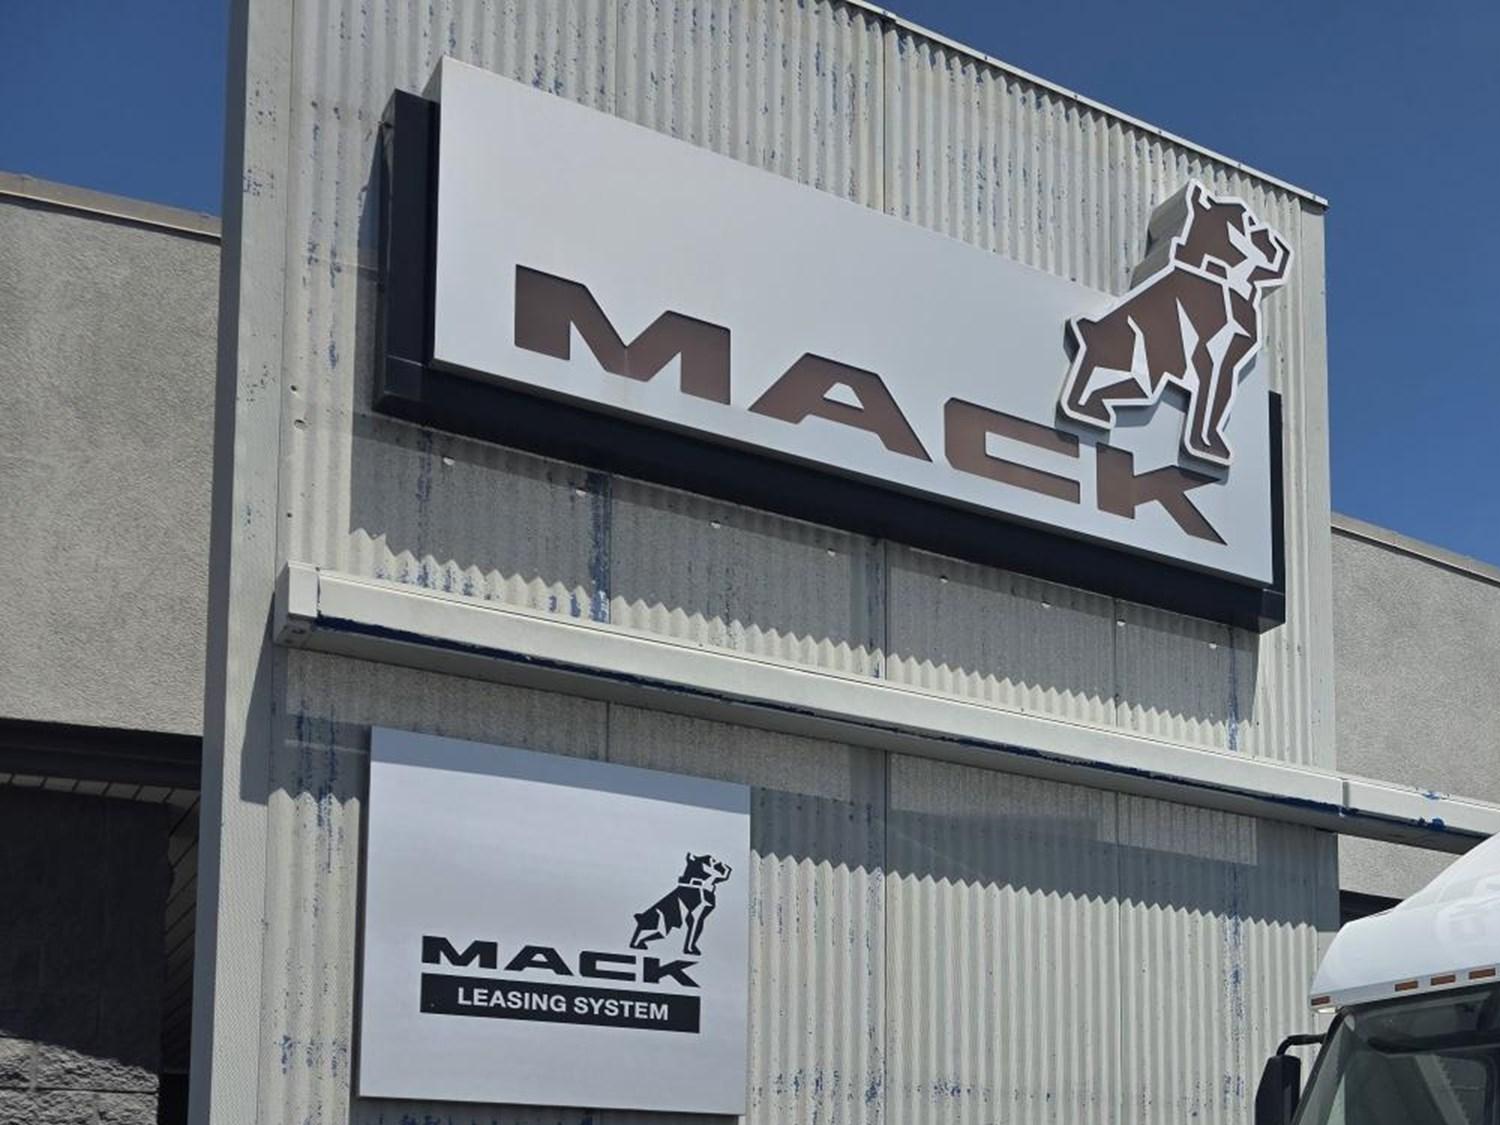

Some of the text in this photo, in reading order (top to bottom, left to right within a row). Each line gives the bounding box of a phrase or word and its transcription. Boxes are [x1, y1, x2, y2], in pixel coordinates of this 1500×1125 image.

[515, 264, 1228, 546] MACK
[421, 935, 701, 988] MACK
[457, 986, 670, 1021] LEASING SYSTEM
